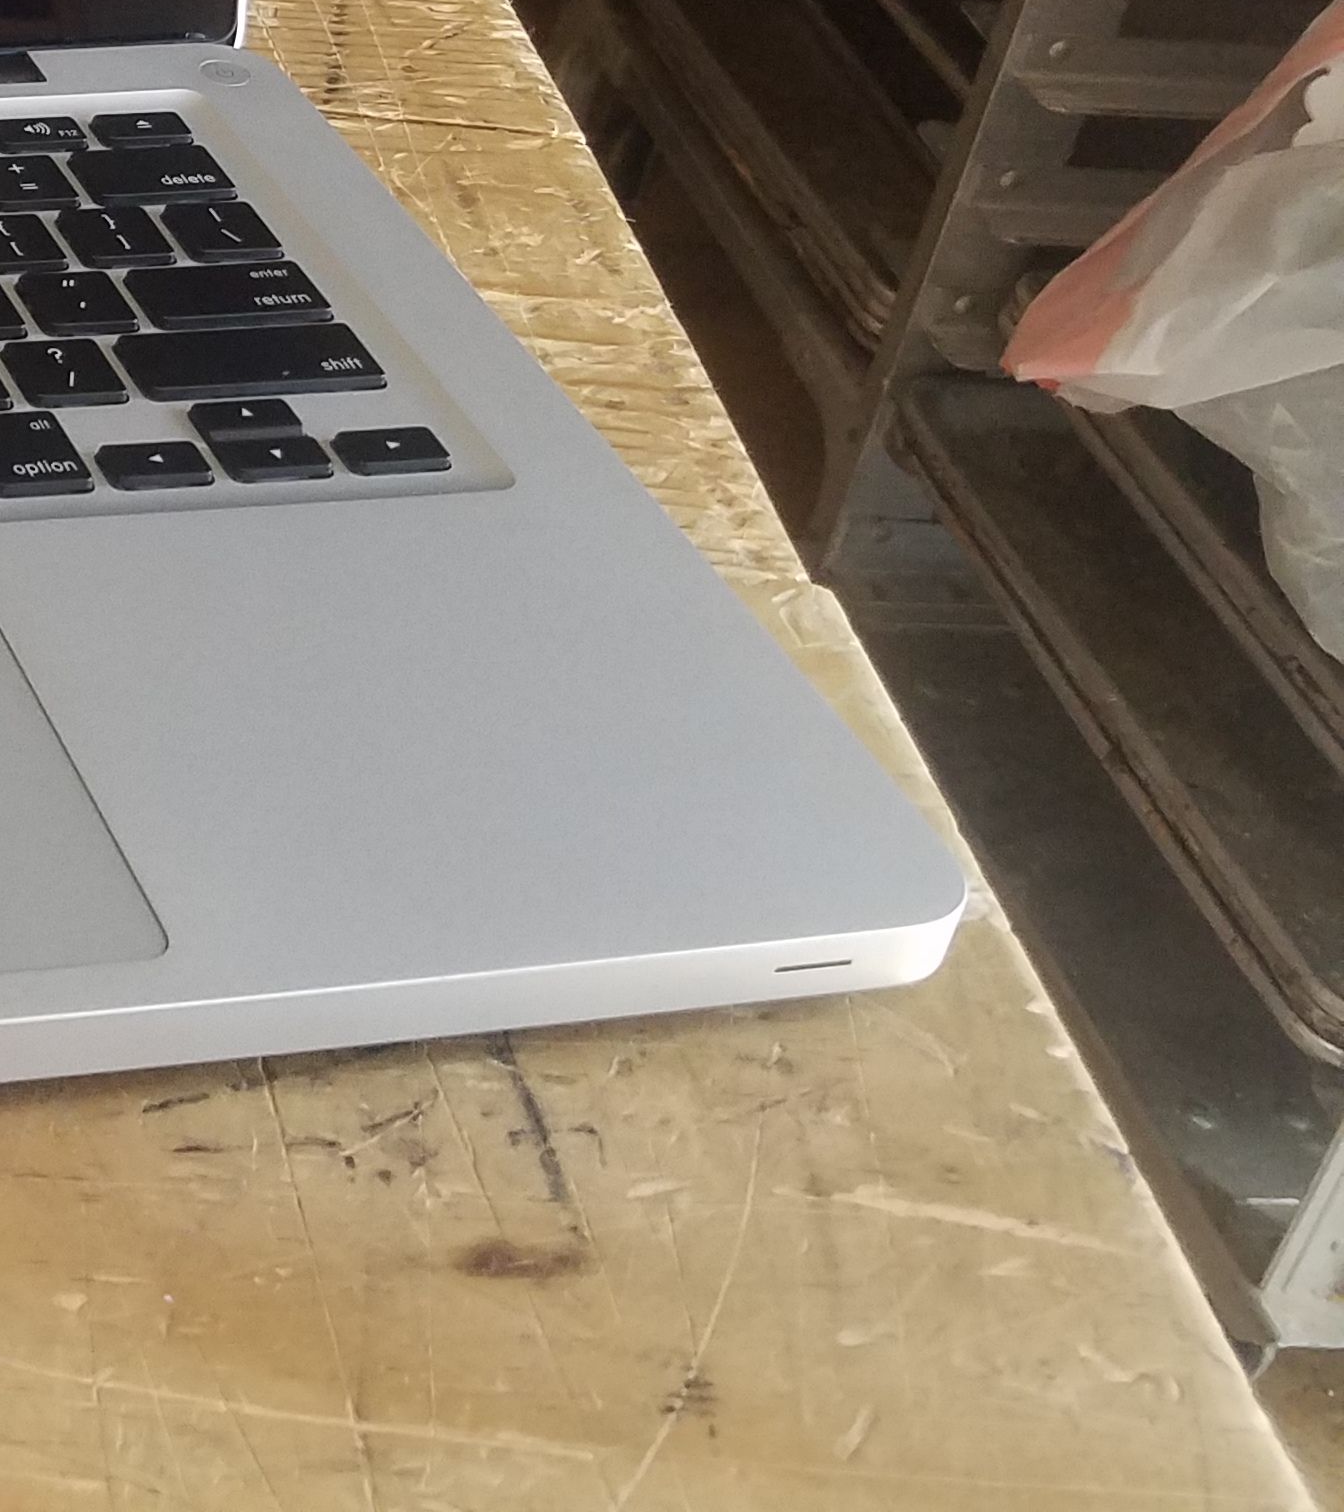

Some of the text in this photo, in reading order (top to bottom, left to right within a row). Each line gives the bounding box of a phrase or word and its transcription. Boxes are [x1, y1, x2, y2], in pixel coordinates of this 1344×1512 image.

[161, 171, 215, 186] delete
[249, 266, 288, 280] enter
[254, 290, 311, 307] return
[47, 348, 63, 364] ?
[320, 355, 363, 372] shift
[29, 419, 51, 431] alt
[13, 458, 77, 477] option
